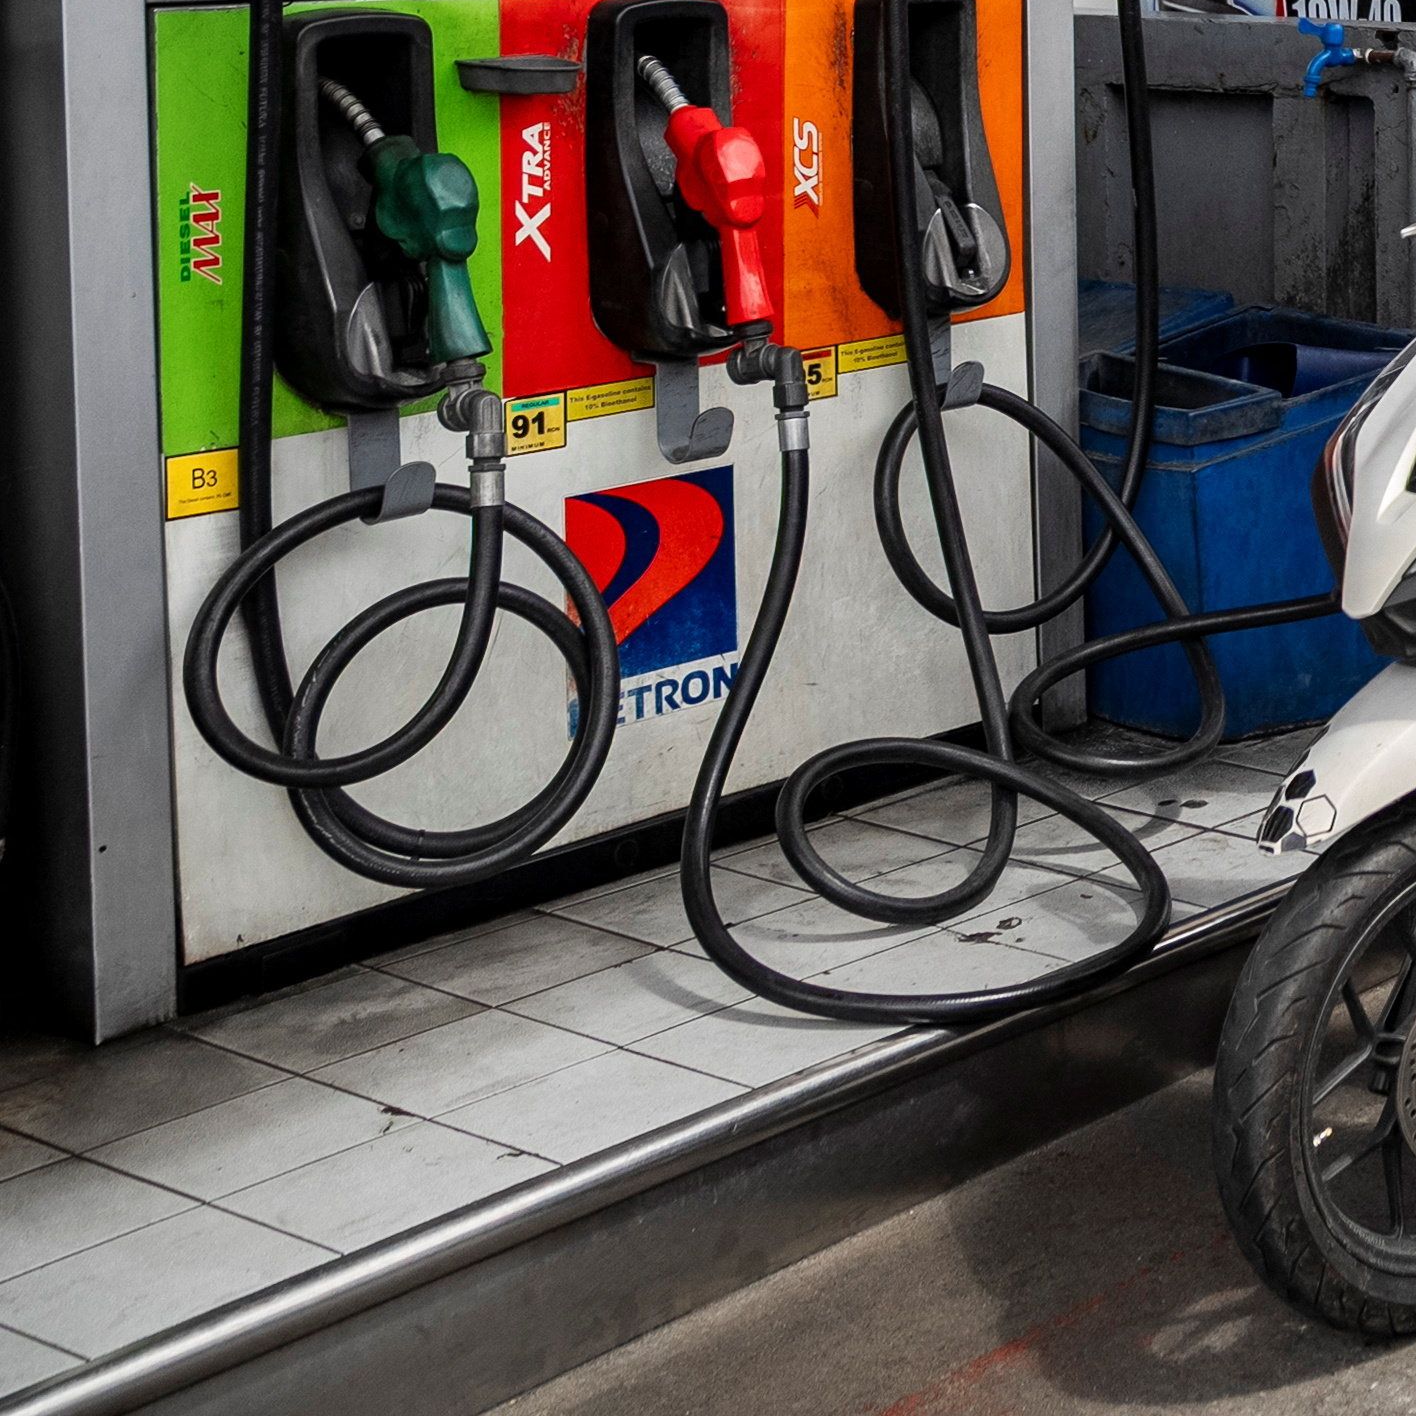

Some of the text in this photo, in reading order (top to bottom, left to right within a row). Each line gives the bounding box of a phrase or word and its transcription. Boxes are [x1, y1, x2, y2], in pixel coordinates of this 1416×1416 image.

[543, 122, 552, 191] ADVANCE
[793, 116, 819, 206] XCS
[515, 122, 551, 263] XTRA
[179, 191, 191, 282] DIESEL
[191, 182, 222, 285] MAX
[569, 395, 584, 403] This
[622, 384, 651, 395] contains
[806, 362, 822, 385] 5
[511, 411, 545, 439] 91
[585, 396, 637, 411] 10% Bioethanol
[192, 467, 218, 490] B3
